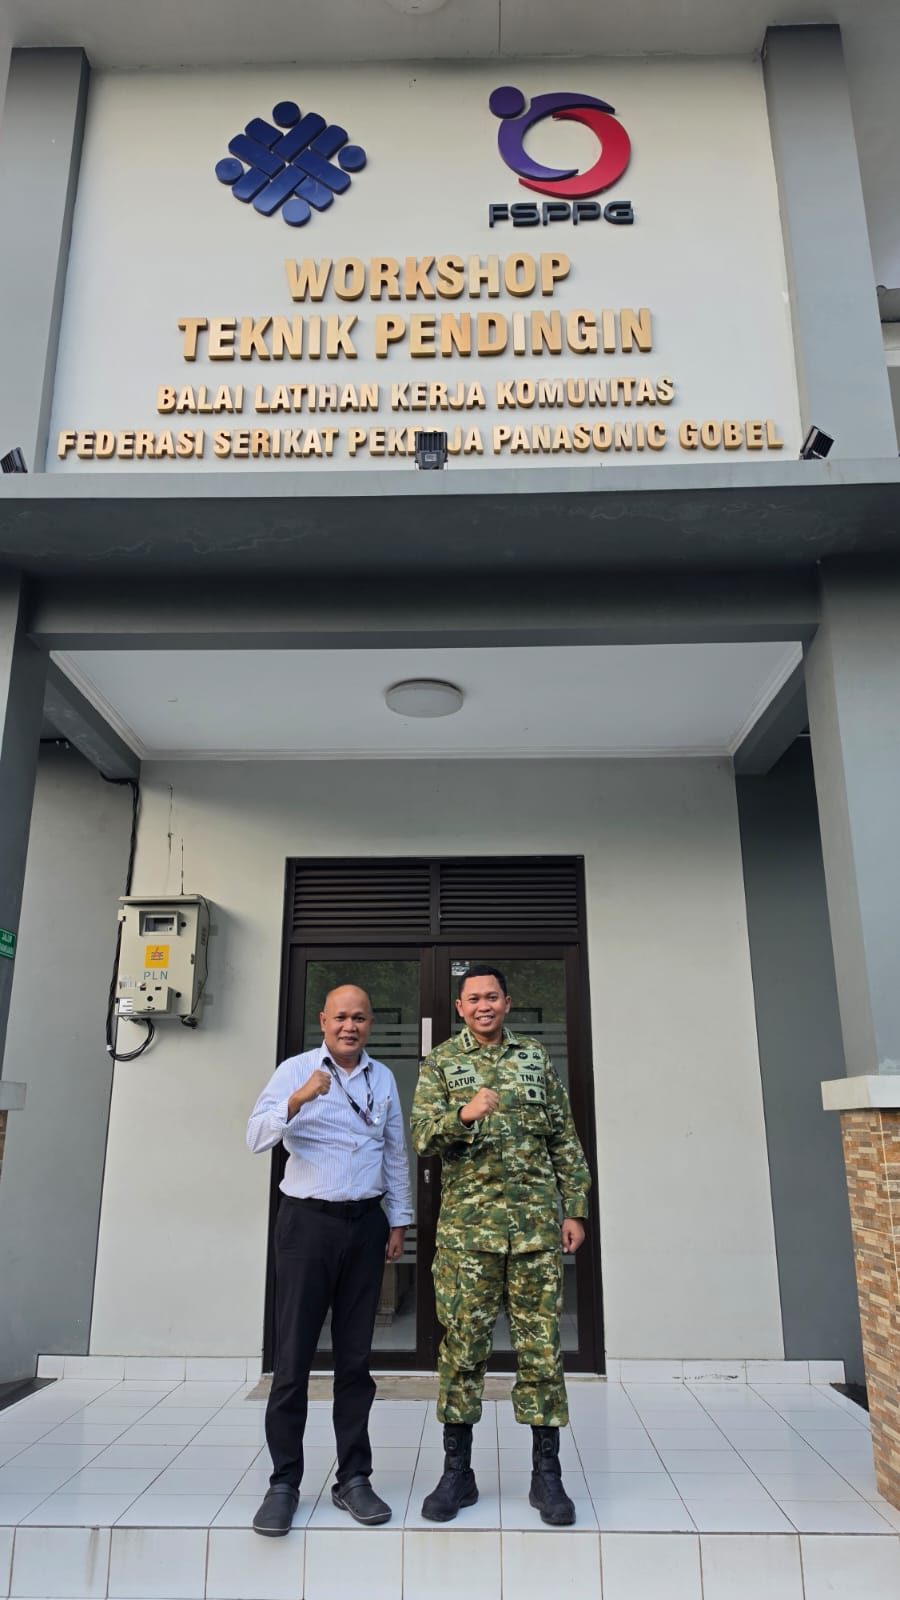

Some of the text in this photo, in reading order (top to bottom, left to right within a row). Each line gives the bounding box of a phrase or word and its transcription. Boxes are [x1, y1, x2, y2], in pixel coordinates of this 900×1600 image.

[488, 201, 634, 227] FSPPG
[285, 253, 571, 301] WORKSHOP
[178, 309, 653, 360] TEKNIK PENDINGIN
[157, 376, 674, 413] BALAI LATIHAN KERJA KOMUNITAS
[57, 419, 784, 458] FEDERASI SERIKAT PEKEJA PANASONIC GOBEL
[143, 971, 168, 980] PLN
[448, 1076, 476, 1089] CATUR
[519, 1074, 535, 1082] TNI
